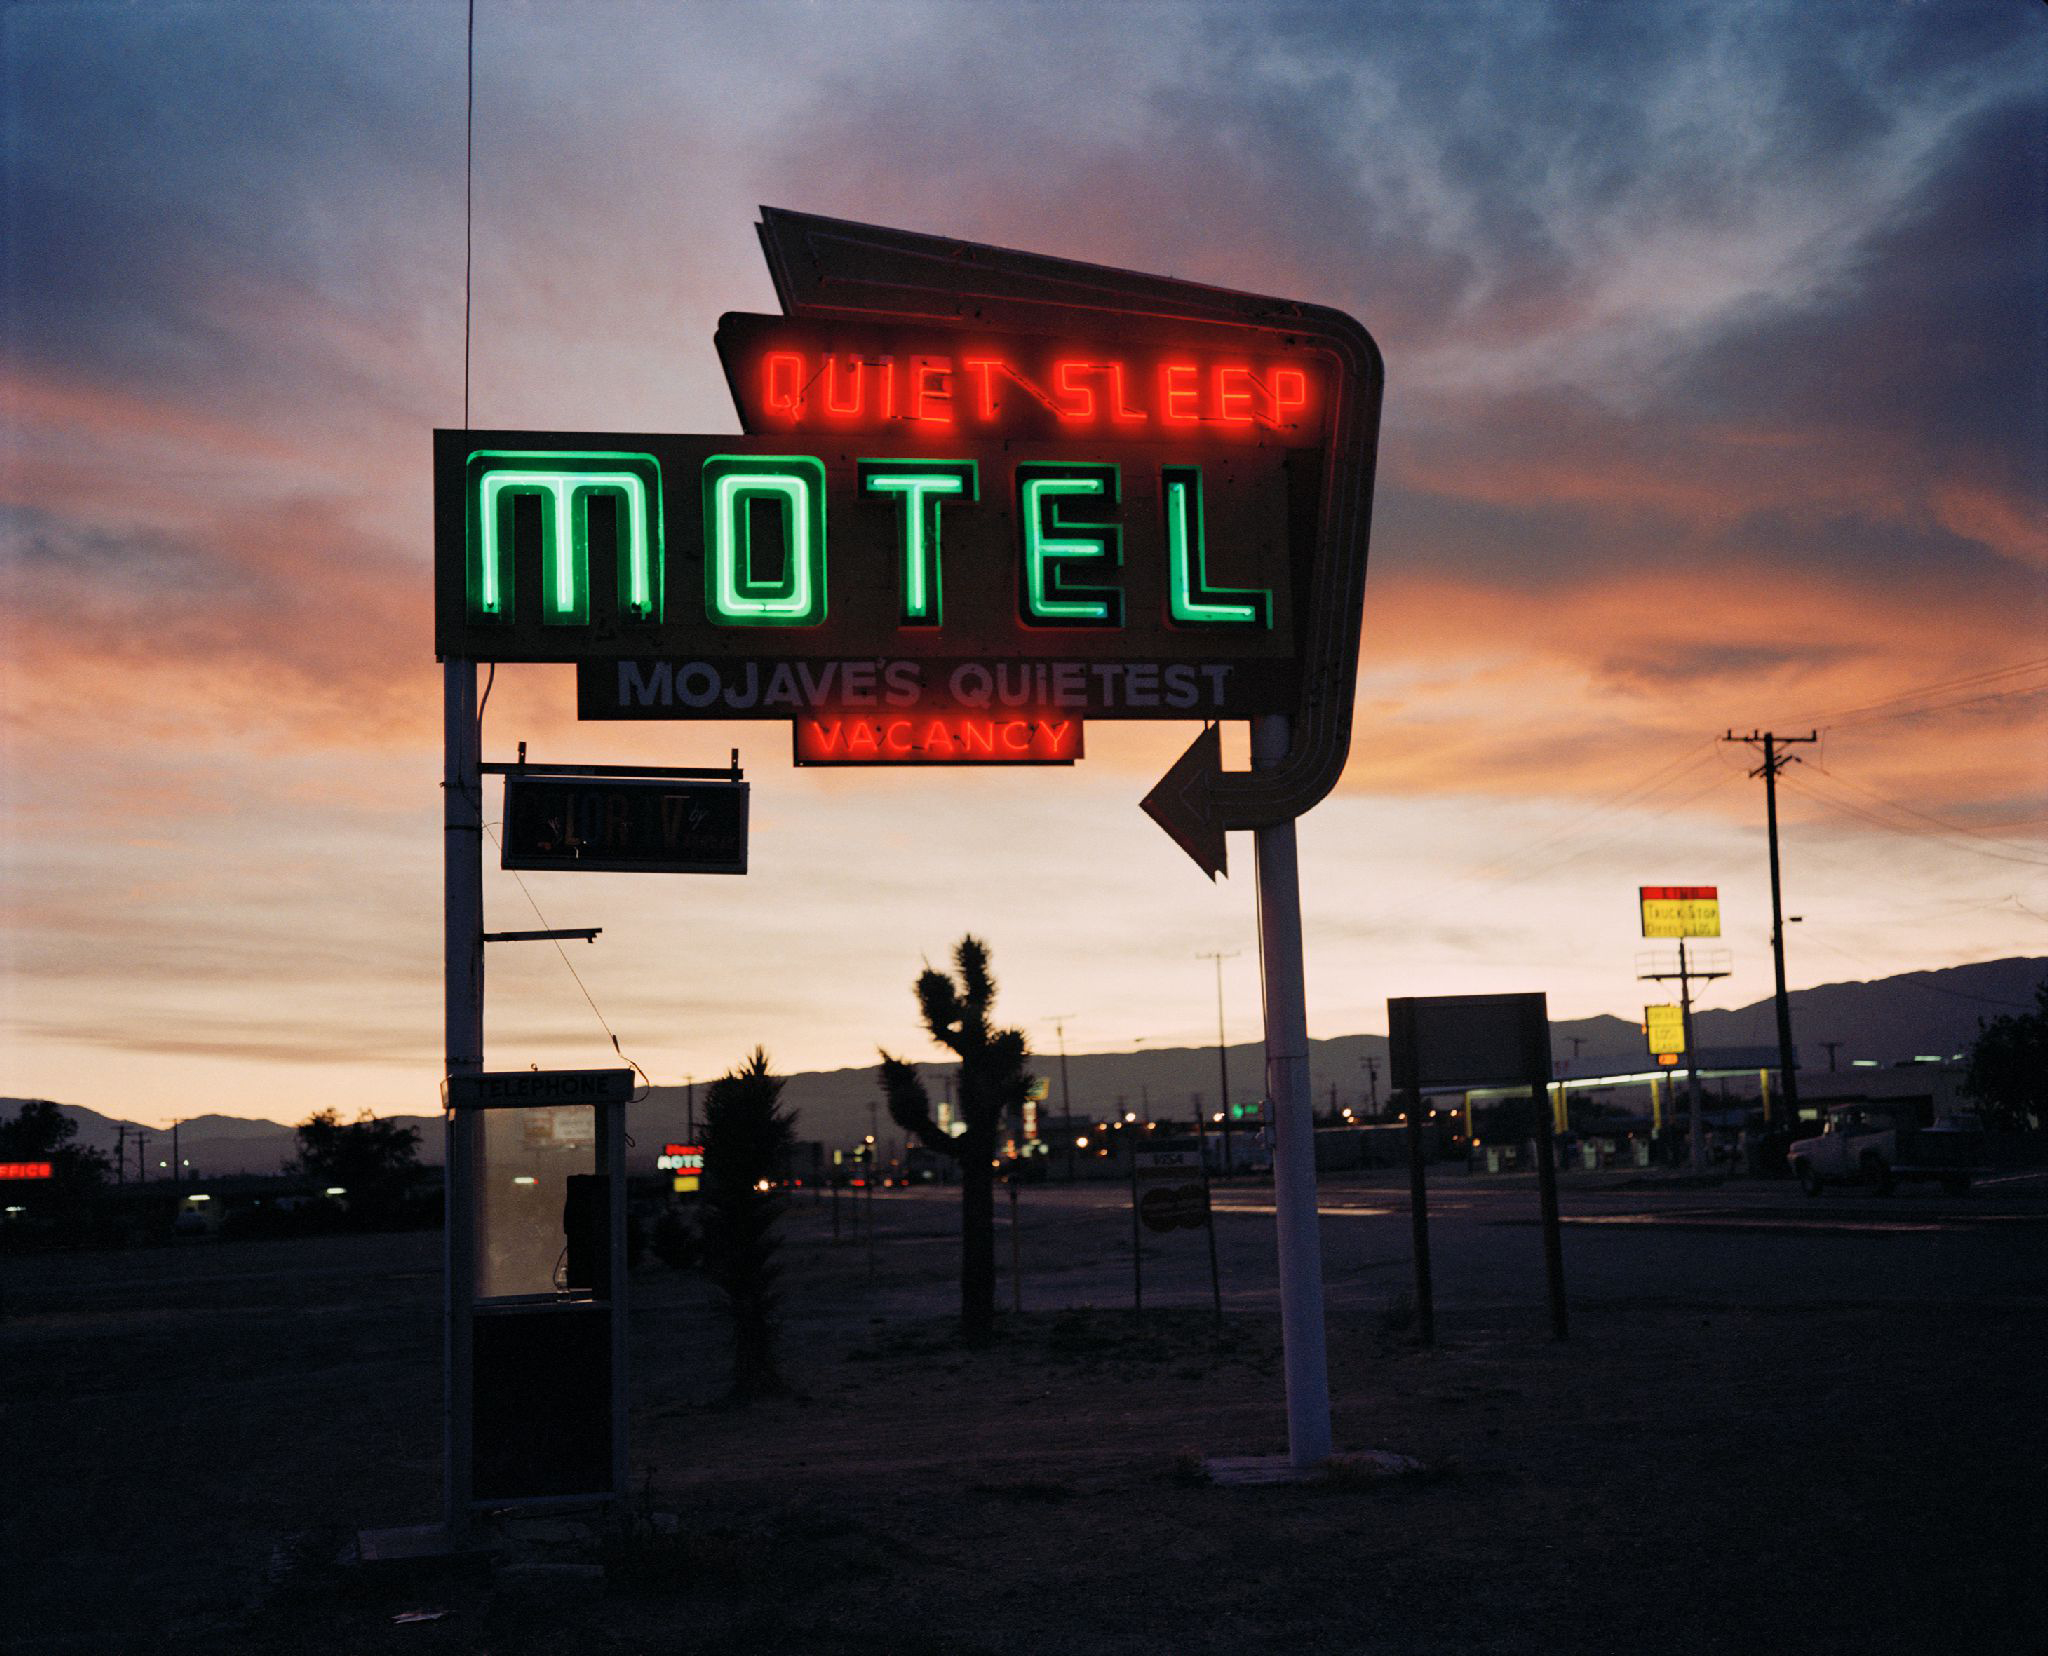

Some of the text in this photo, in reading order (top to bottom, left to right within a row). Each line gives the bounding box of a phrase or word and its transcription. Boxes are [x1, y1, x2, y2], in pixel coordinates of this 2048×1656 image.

[765, 353, 1306, 429] QUIET SLEEP
[466, 450, 1274, 630] MOTEL
[617, 658, 922, 711] MOJAVE'S
[812, 719, 1072, 755] VACANCY
[474, 1076, 609, 1098] TELEPHONE
